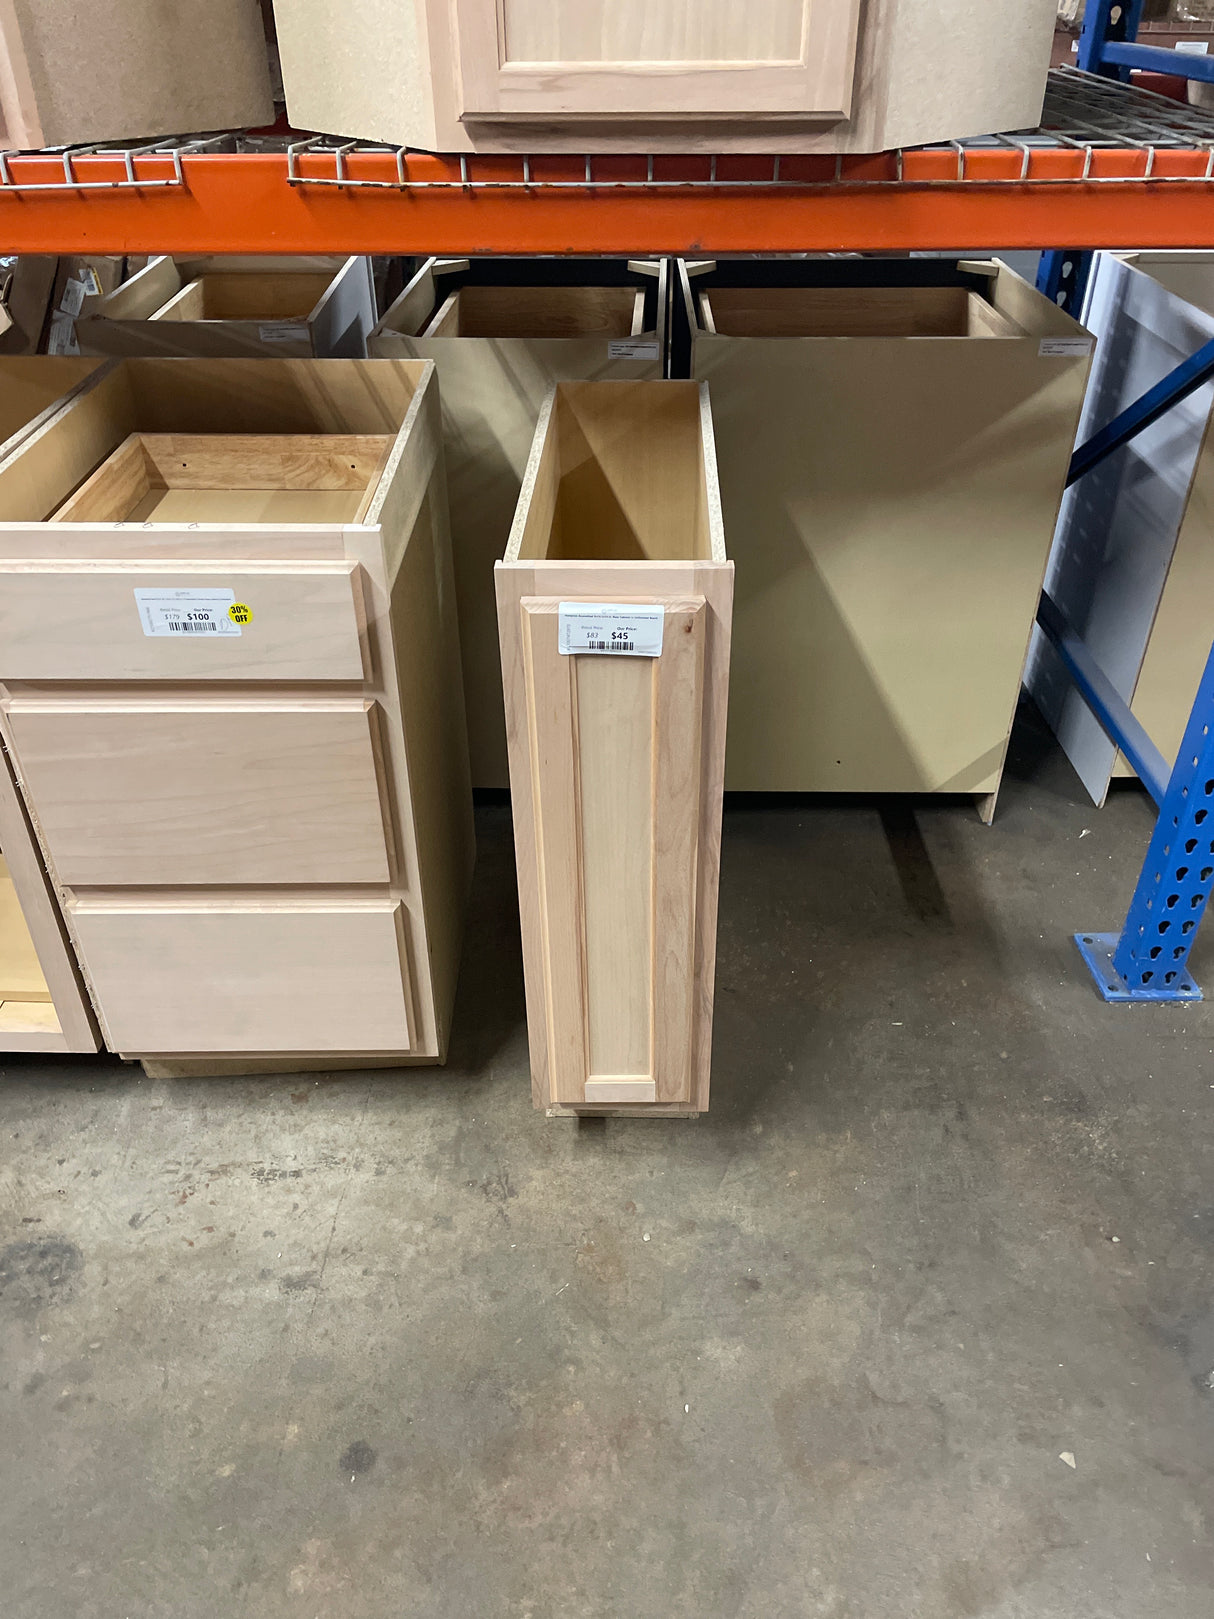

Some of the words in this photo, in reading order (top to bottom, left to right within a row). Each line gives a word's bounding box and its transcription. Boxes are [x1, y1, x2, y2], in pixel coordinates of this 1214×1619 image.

[230, 605, 249, 614] 30%
[187, 613, 210, 621] $100
[234, 614, 248, 623] OFF
[586, 631, 599, 639] $83
[611, 631, 629, 640] $45
